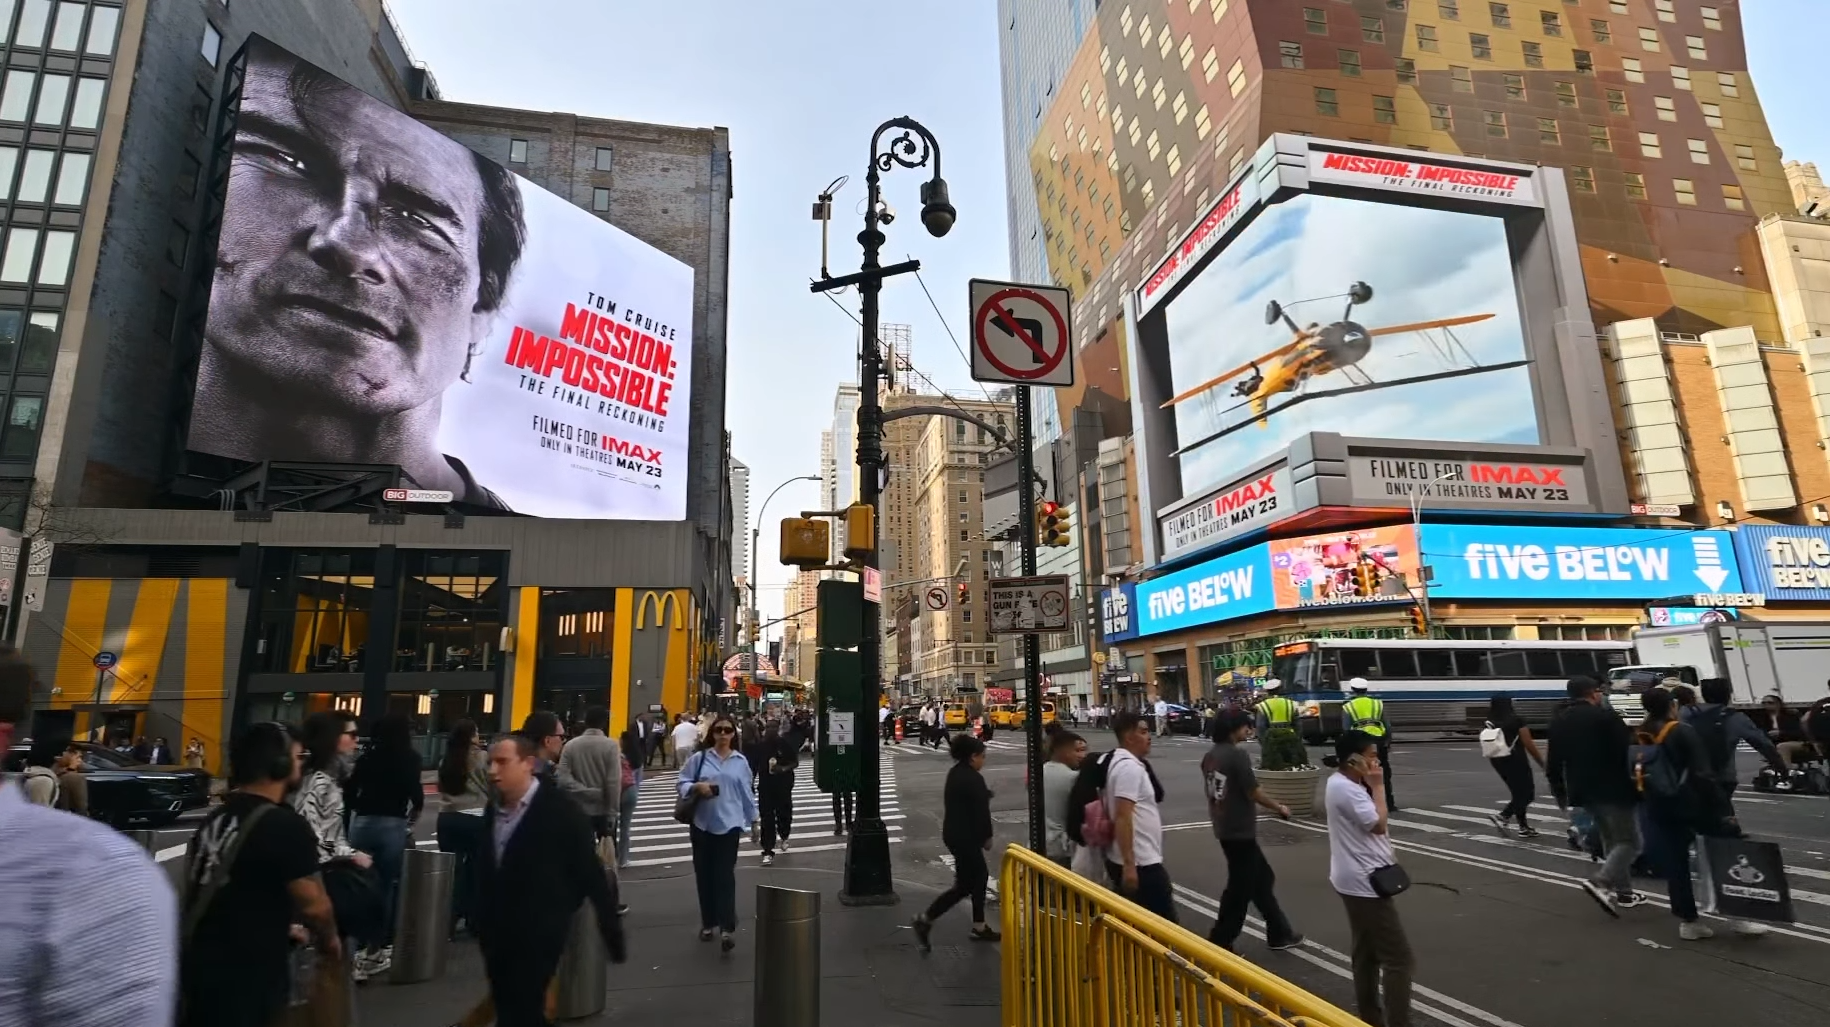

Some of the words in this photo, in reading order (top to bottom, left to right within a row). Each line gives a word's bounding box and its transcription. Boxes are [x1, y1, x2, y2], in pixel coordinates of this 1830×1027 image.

[1323, 153, 1413, 178] MISSION:
[1416, 164, 1519, 190] IMPOSSIBLE
[1383, 176, 1404, 187] THE
[1411, 179, 1444, 191] FINAL
[1451, 184, 1513, 198] RECKONING
[1182, 185, 1241, 261] IMPOSSIBLE
[588, 291, 617, 315] TOM
[625, 309, 676, 341] CRUISE
[559, 302, 677, 380] MISSION:
[505, 326, 673, 417] IMPOSSIBLE
[519, 374, 546, 395] THE
[552, 386, 590, 410] FINAL
[598, 400, 666, 433] RECKONING
[533, 415, 574, 441] FILMED
[578, 428, 599, 448] FOR
[601, 435, 663, 466] IMAX
[541, 436, 560, 451] ONLY
[564, 442, 572, 455] IN
[576, 445, 613, 465] THEATRES
[616, 456, 643, 473] MAY
[646, 464, 663, 478] 23
[1371, 459, 1428, 480] FILMED
[1434, 462, 1465, 482] FOR
[1470, 464, 1566, 487] IMAX
[1386, 482, 1413, 495] ONLY
[1419, 483, 1431, 496] IN
[1436, 484, 1493, 499] THEATRES
[1497, 486, 1537, 500] MAY
[1542, 488, 1570, 501] 23
[387, 490, 405, 499] BIG
[409, 492, 449, 500] OUTDOOR
[1169, 511, 1195, 537] FILMED
[1197, 503, 1213, 525] FOR
[1215, 474, 1276, 517] IMAX
[1199, 517, 1228, 539] THEATRES
[1231, 505, 1256, 526] MAY
[1259, 496, 1277, 514] 23
[1464, 543, 1550, 580] five
[1764, 536, 1830, 567] five
[993, 601, 1012, 609] GUN
[1027, 590, 1033, 598] A
[1148, 586, 1186, 620] five
